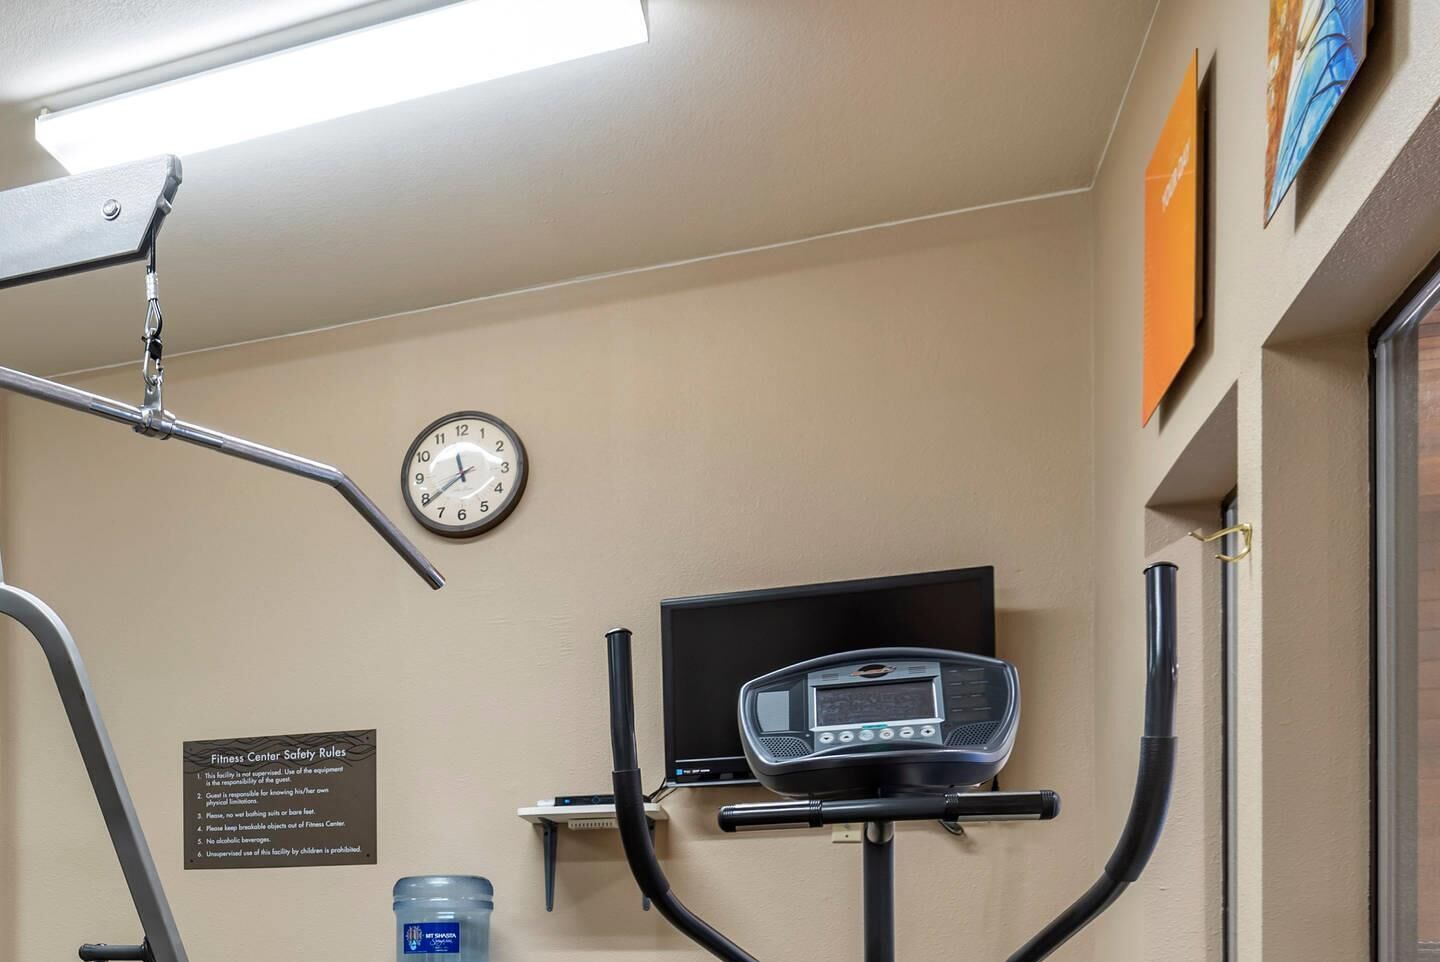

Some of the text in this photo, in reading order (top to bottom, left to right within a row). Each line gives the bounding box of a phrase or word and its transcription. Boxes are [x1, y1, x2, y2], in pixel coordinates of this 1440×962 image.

[456, 425, 468, 436] 12
[480, 428, 484, 438] 1
[435, 434, 445, 444] 11
[496, 441, 504, 451] 2
[417, 451, 430, 462] 10
[501, 462, 509, 473] 3
[416, 473, 424, 484] 9
[494, 483, 503, 493] 4
[422, 494, 430, 505] 8
[480, 501, 488, 512] 5
[438, 507, 445, 518] 7
[458, 510, 466, 520] 6
[211, 746, 346, 764] Fitness Center Safety Rules
[252, 769, 282, 777] supervised.
[313, 766, 343, 775] equipment
[221, 777, 257, 786] responsibility
[228, 790, 260, 798] responsible
[270, 788, 293, 796] knowing
[206, 798, 228, 806] physical
[245, 810, 267, 818] bathing
[206, 850, 242, 858] Unsupervised
[330, 846, 362, 854] prohibited.
